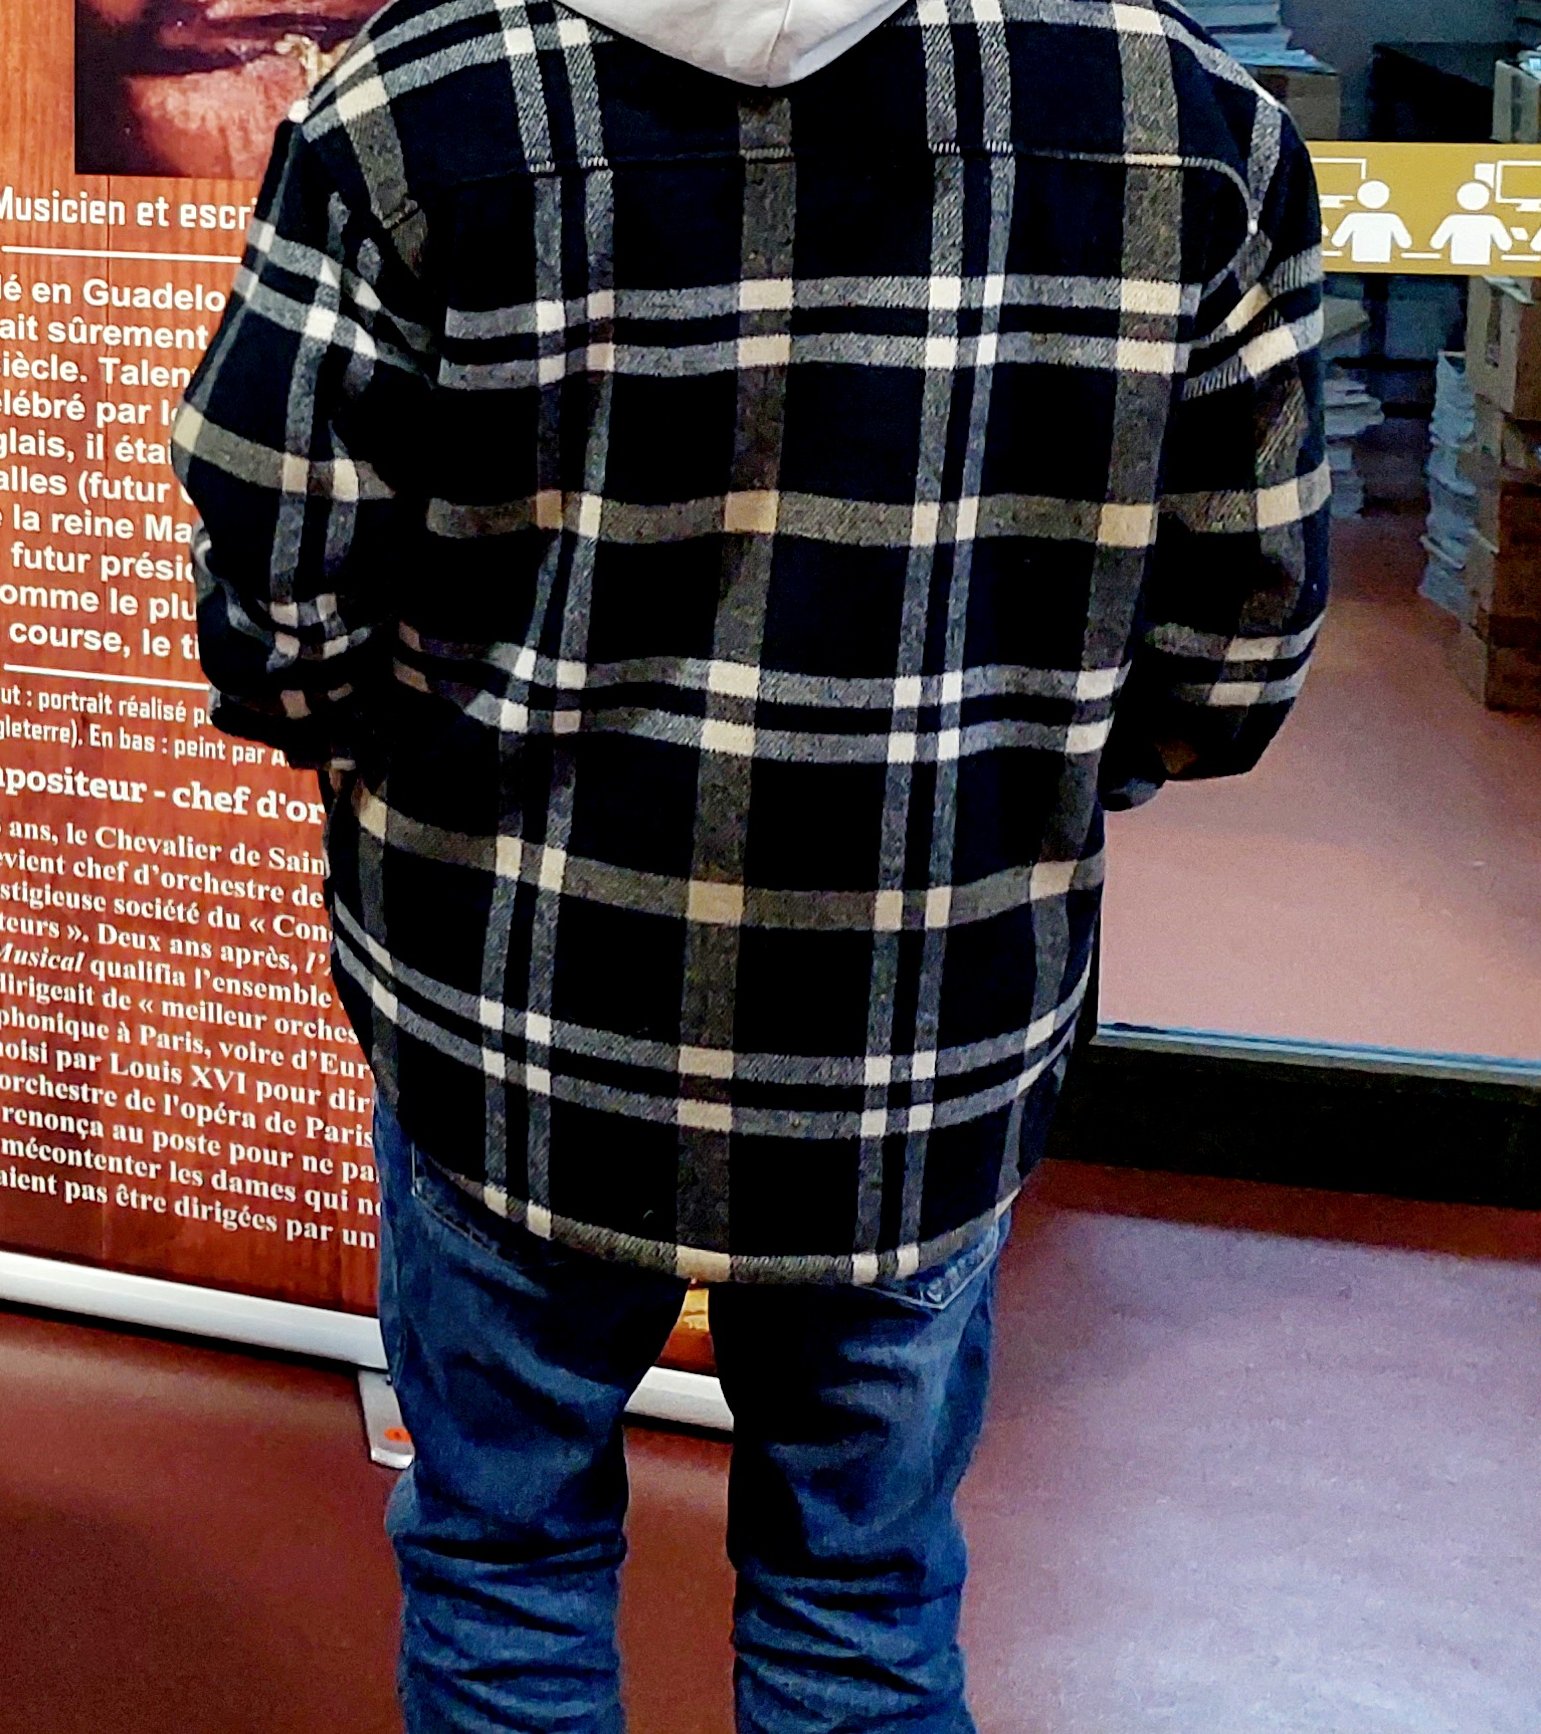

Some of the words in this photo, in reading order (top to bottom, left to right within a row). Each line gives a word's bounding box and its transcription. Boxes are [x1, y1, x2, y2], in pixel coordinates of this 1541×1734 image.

[137, 197, 169, 226] et
[32, 283, 71, 304] en
[48, 317, 208, 350] sûrement
[79, 471, 170, 504] (futur
[14, 504, 39, 531] la
[52, 510, 133, 538] reine
[172, 781, 251, 815] chef
[10, 822, 58, 844] ans,
[67, 823, 87, 845] le
[95, 827, 222, 861] Chevalier
[230, 843, 260, 866] de
[57, 1050, 101, 1071] par
[111, 1052, 181, 1084] Louis
[191, 1065, 245, 1094] XVI
[257, 1081, 321, 1105] pour
